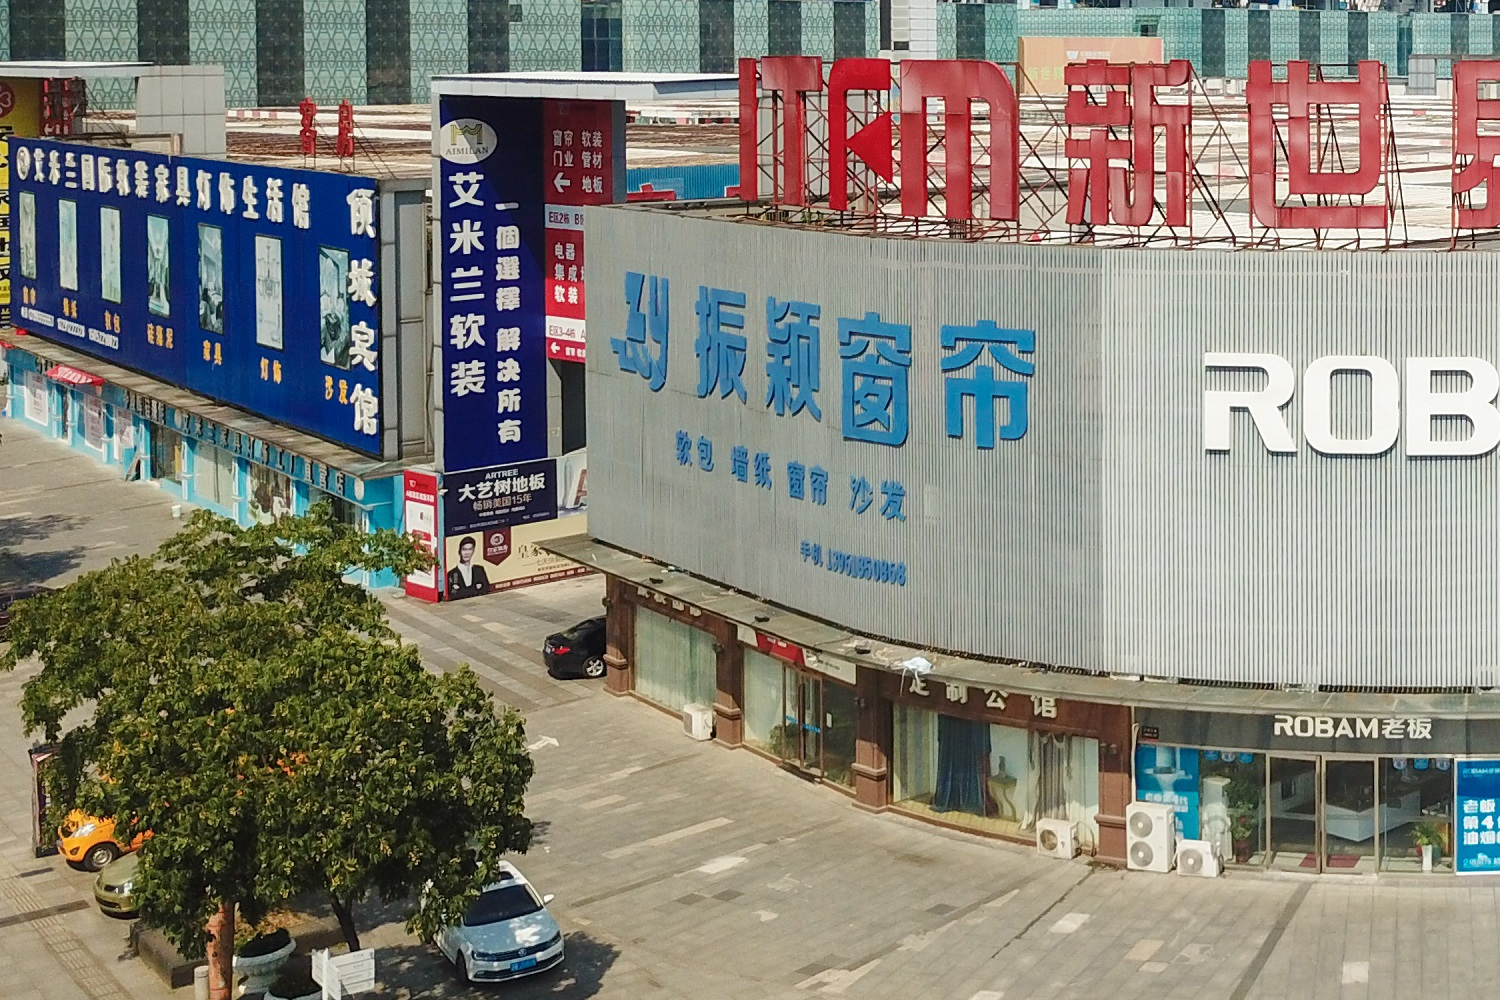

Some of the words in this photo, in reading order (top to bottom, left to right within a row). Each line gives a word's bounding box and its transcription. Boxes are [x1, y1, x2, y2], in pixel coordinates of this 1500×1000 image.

[552, 130, 574, 148] 窗帘
[581, 130, 603, 148] 软装
[445, 146, 489, 156] AIMILAN
[552, 150, 574, 168] 门业
[581, 151, 603, 169] 管材
[581, 175, 604, 194] 地板
[554, 242, 576, 261] 电器
[448, 171, 486, 398] 艾米兰软装
[693, 284, 1036, 450] 振颖窗帘
[484, 468, 519, 481] ARTREE
[675, 429, 715, 472] 软包
[731, 445, 773, 491] 墙纸
[786, 460, 829, 506] 窗帘
[848, 474, 907, 523] 沙发
[458, 472, 547, 503] 大艺树地板
[1273, 714, 1433, 741] ROBAM老板
